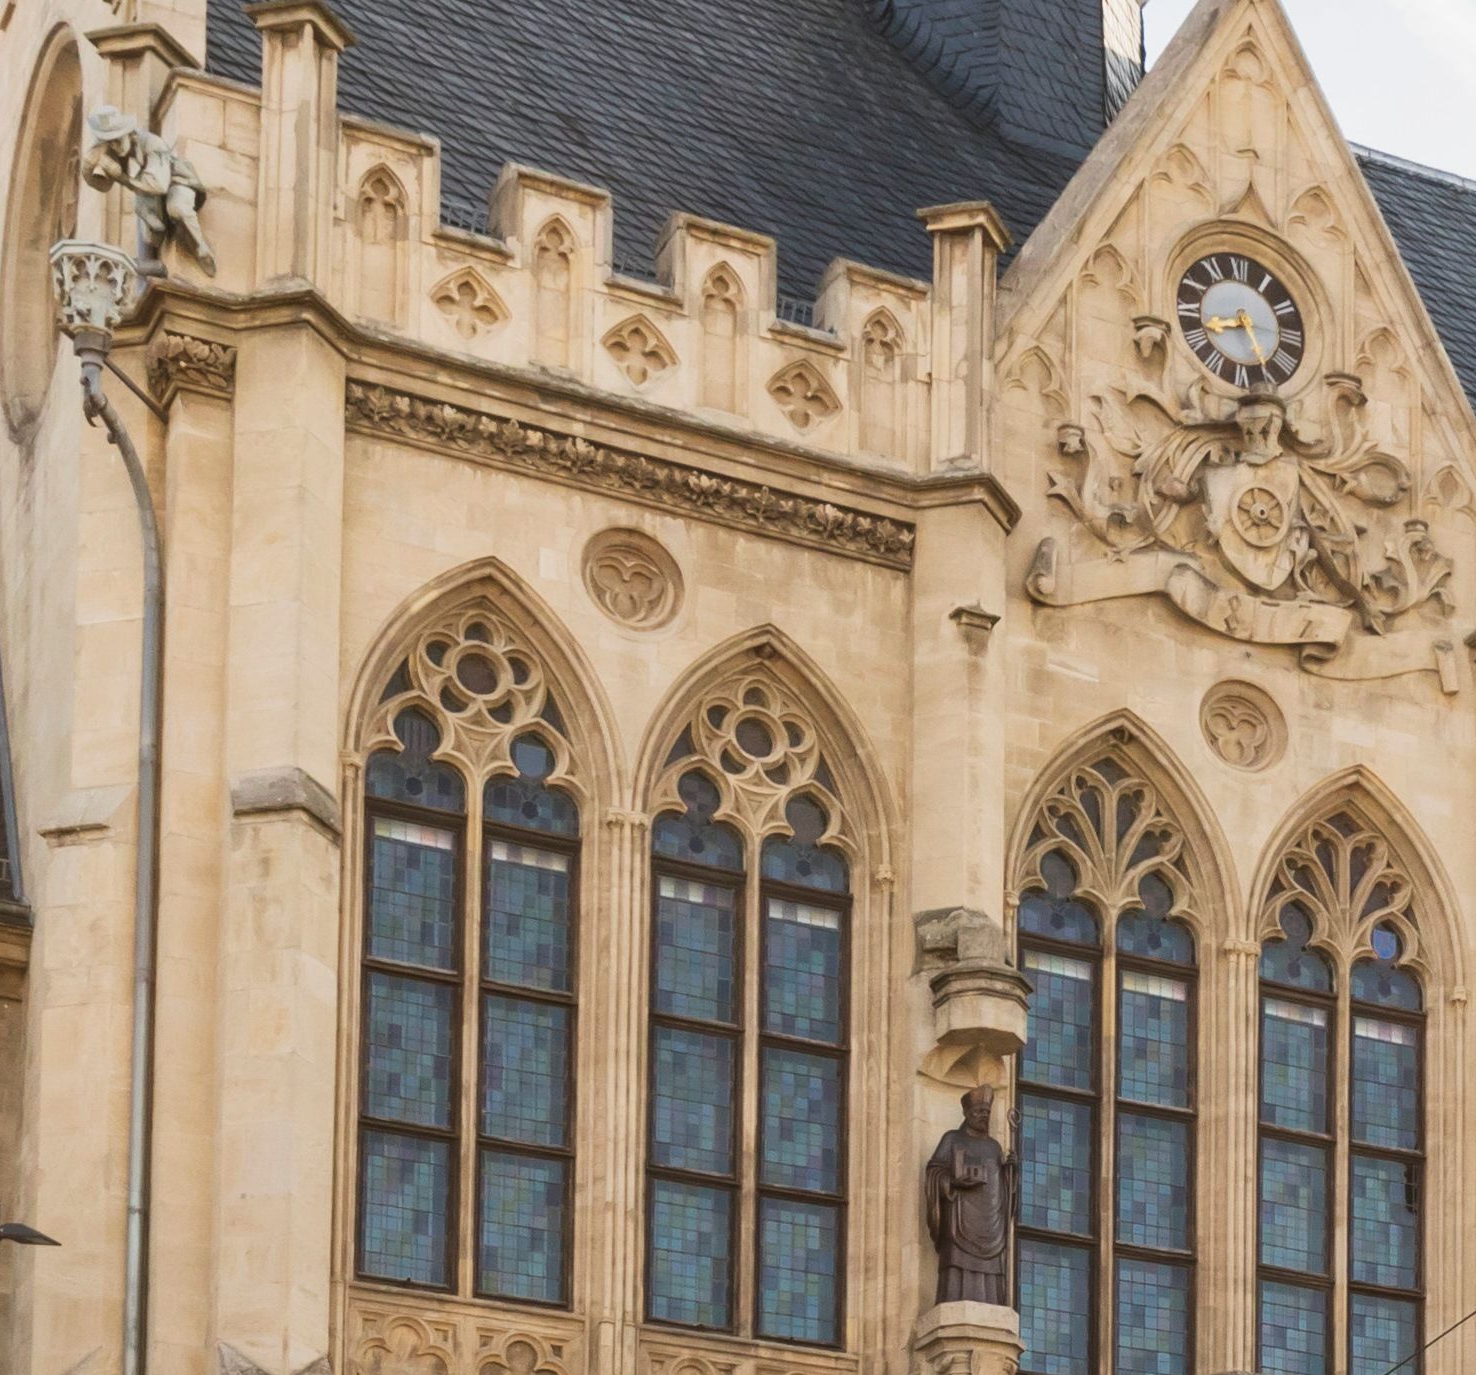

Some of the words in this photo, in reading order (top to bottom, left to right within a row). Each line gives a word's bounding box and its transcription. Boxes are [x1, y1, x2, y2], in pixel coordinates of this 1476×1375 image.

[1200, 256, 1224, 283] XI
[1230, 256, 1248, 283] XII
[1182, 273, 1208, 295] X
[1258, 273, 1272, 293] I
[1177, 298, 1200, 318] IX
[1274, 299, 1295, 315] II
[1280, 327, 1302, 347] III
[1204, 349, 1225, 376] VII
[1235, 364, 1249, 388] VI
